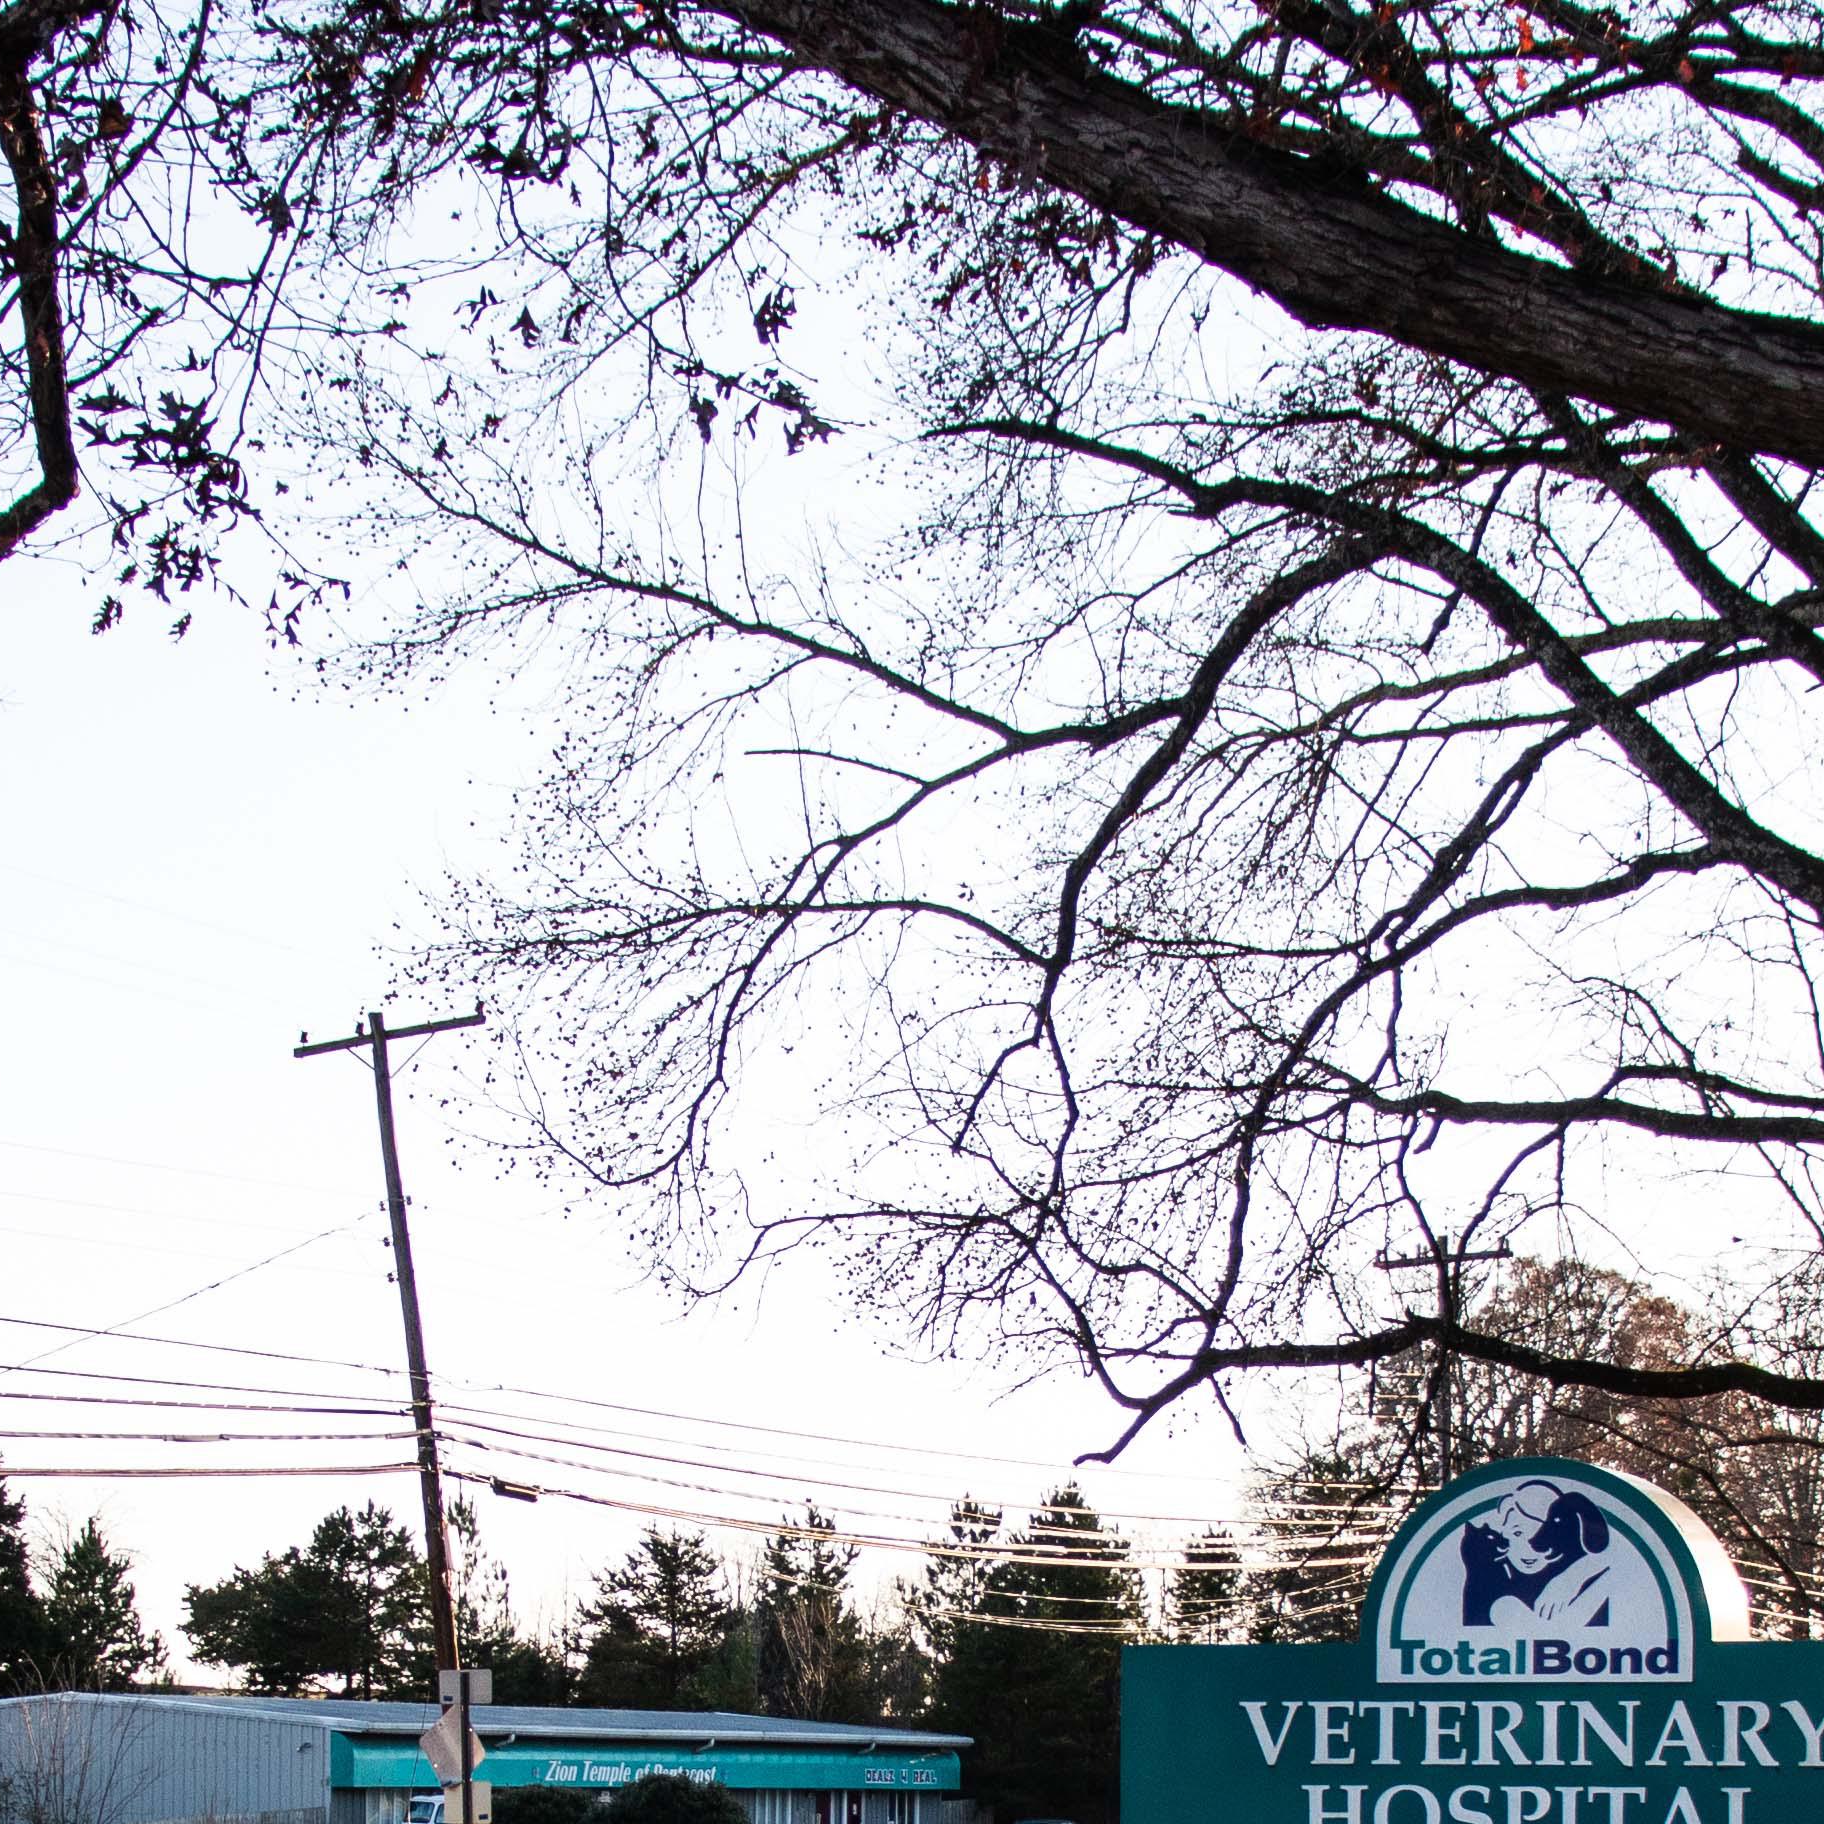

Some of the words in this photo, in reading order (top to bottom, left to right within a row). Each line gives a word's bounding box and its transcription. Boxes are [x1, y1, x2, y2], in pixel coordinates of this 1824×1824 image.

[1394, 1638, 1679, 1676] TotalBond
[545, 1761, 578, 1782] Zion
[582, 1760, 631, 1786] Temple
[654, 1764, 717, 1784] Ptcost
[901, 1768, 909, 1784] 4
[912, 1769, 937, 1784] REAL
